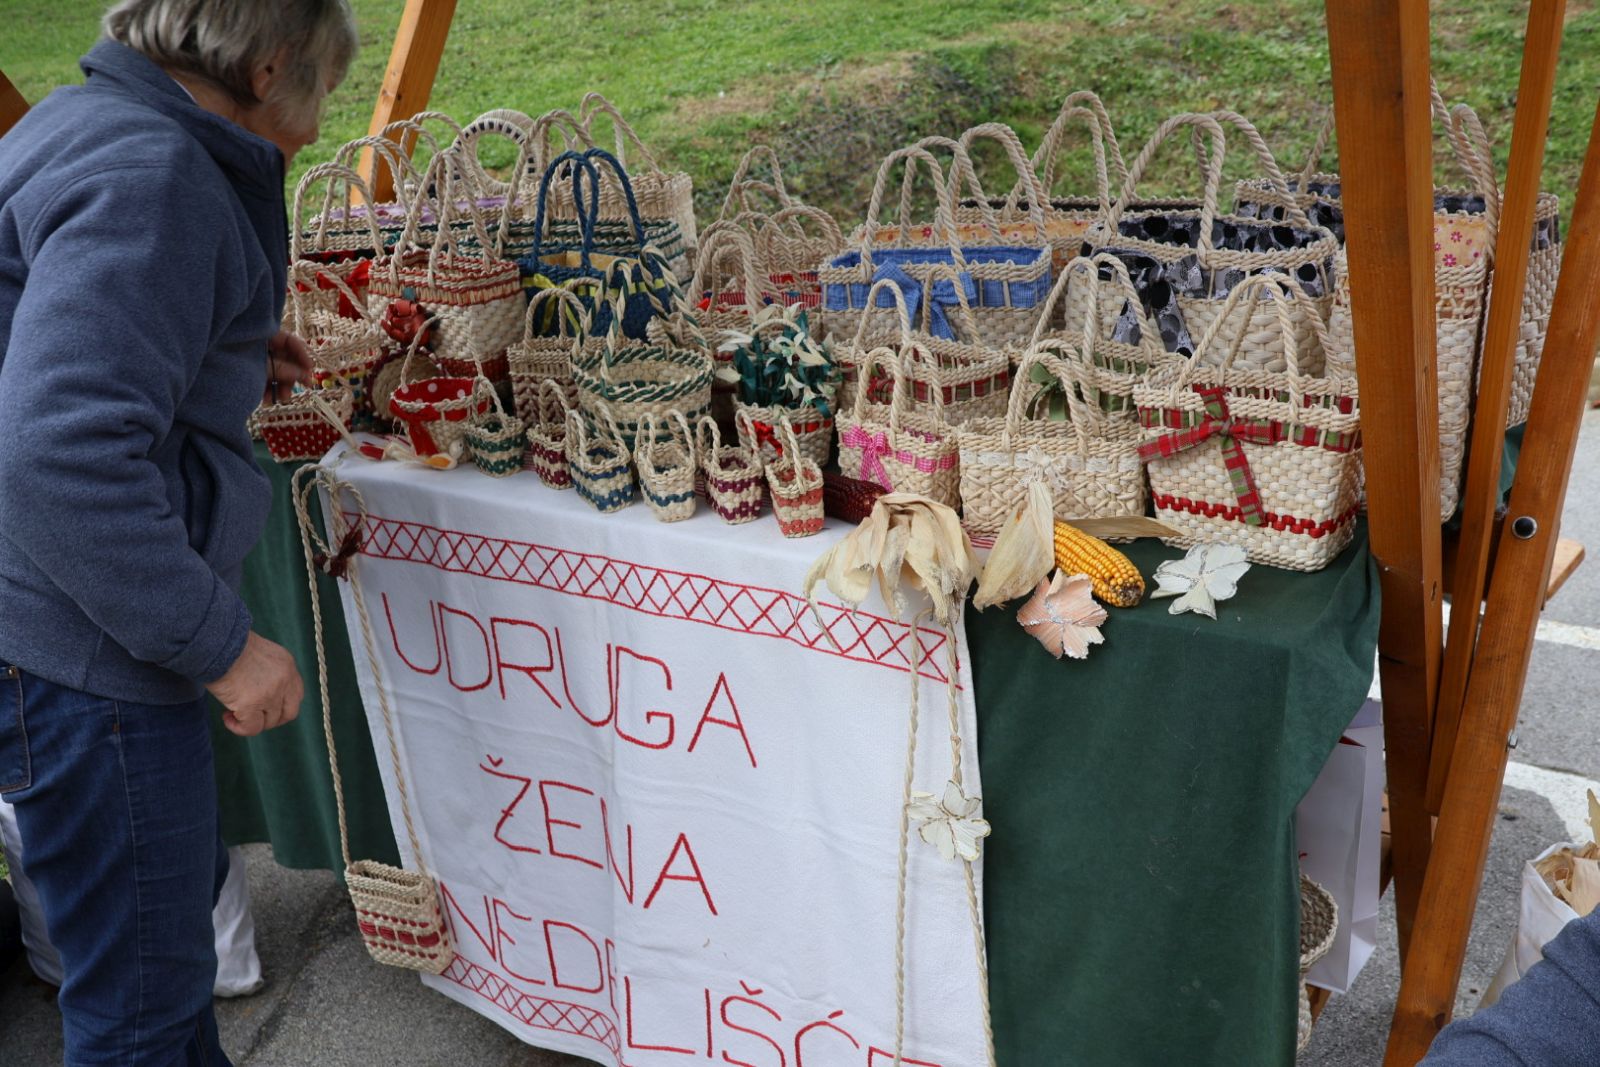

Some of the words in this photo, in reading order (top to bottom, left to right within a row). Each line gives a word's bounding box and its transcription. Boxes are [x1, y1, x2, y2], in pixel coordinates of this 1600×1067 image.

[381, 592, 758, 768] UDRUGA
[479, 754, 718, 915] ŽENA
[440, 881, 943, 1067] NEDELIŠĆ
